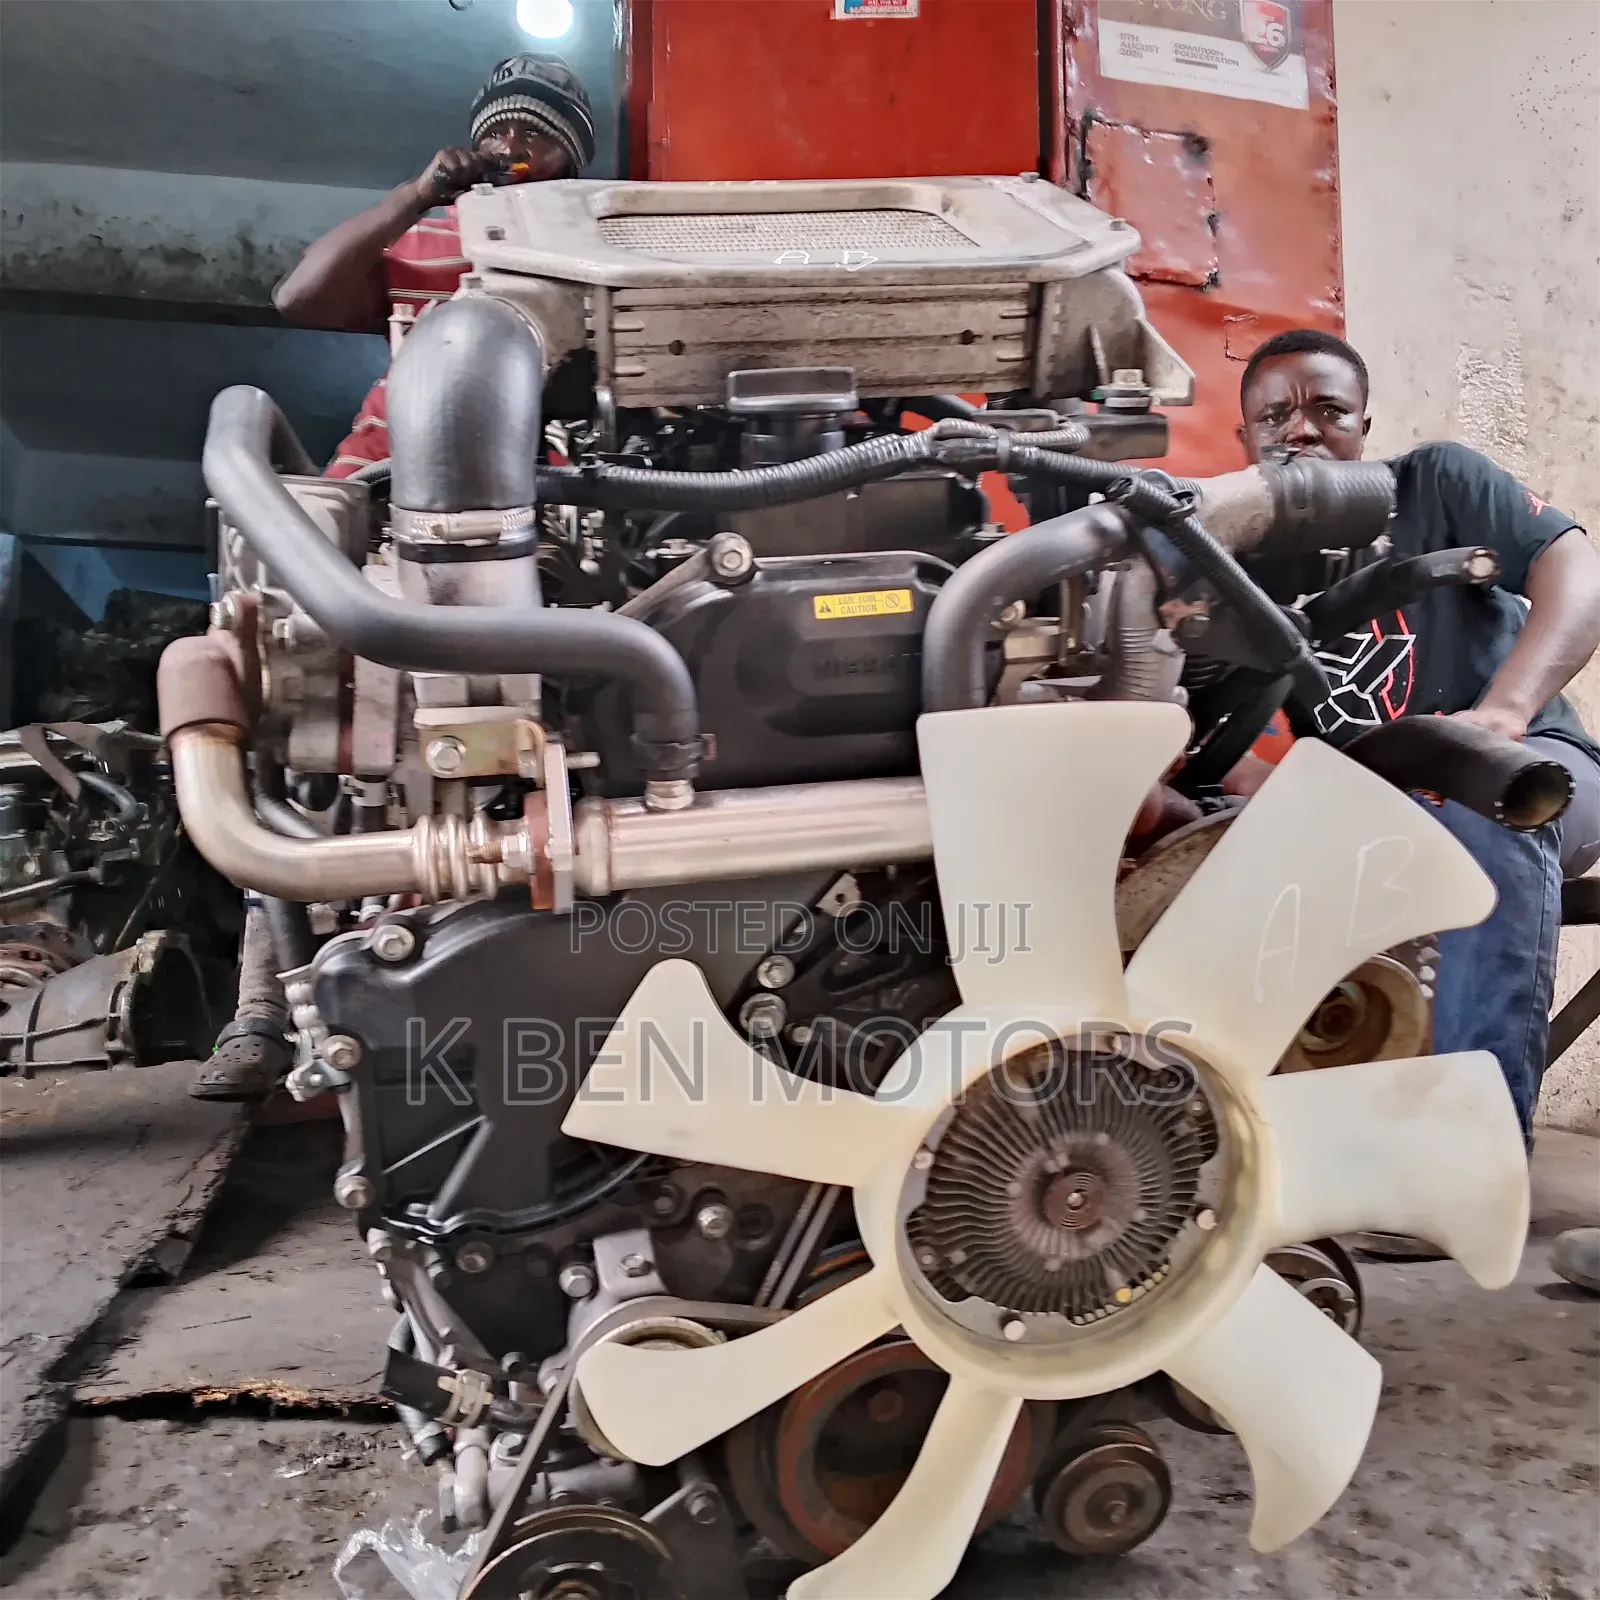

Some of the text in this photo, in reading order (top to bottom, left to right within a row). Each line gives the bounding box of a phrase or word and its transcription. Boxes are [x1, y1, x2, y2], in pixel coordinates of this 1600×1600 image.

[1120, 41, 1160, 54] AUGUST
[1205, 55, 1240, 67] STATION
[840, 604, 877, 615] CAUTION
